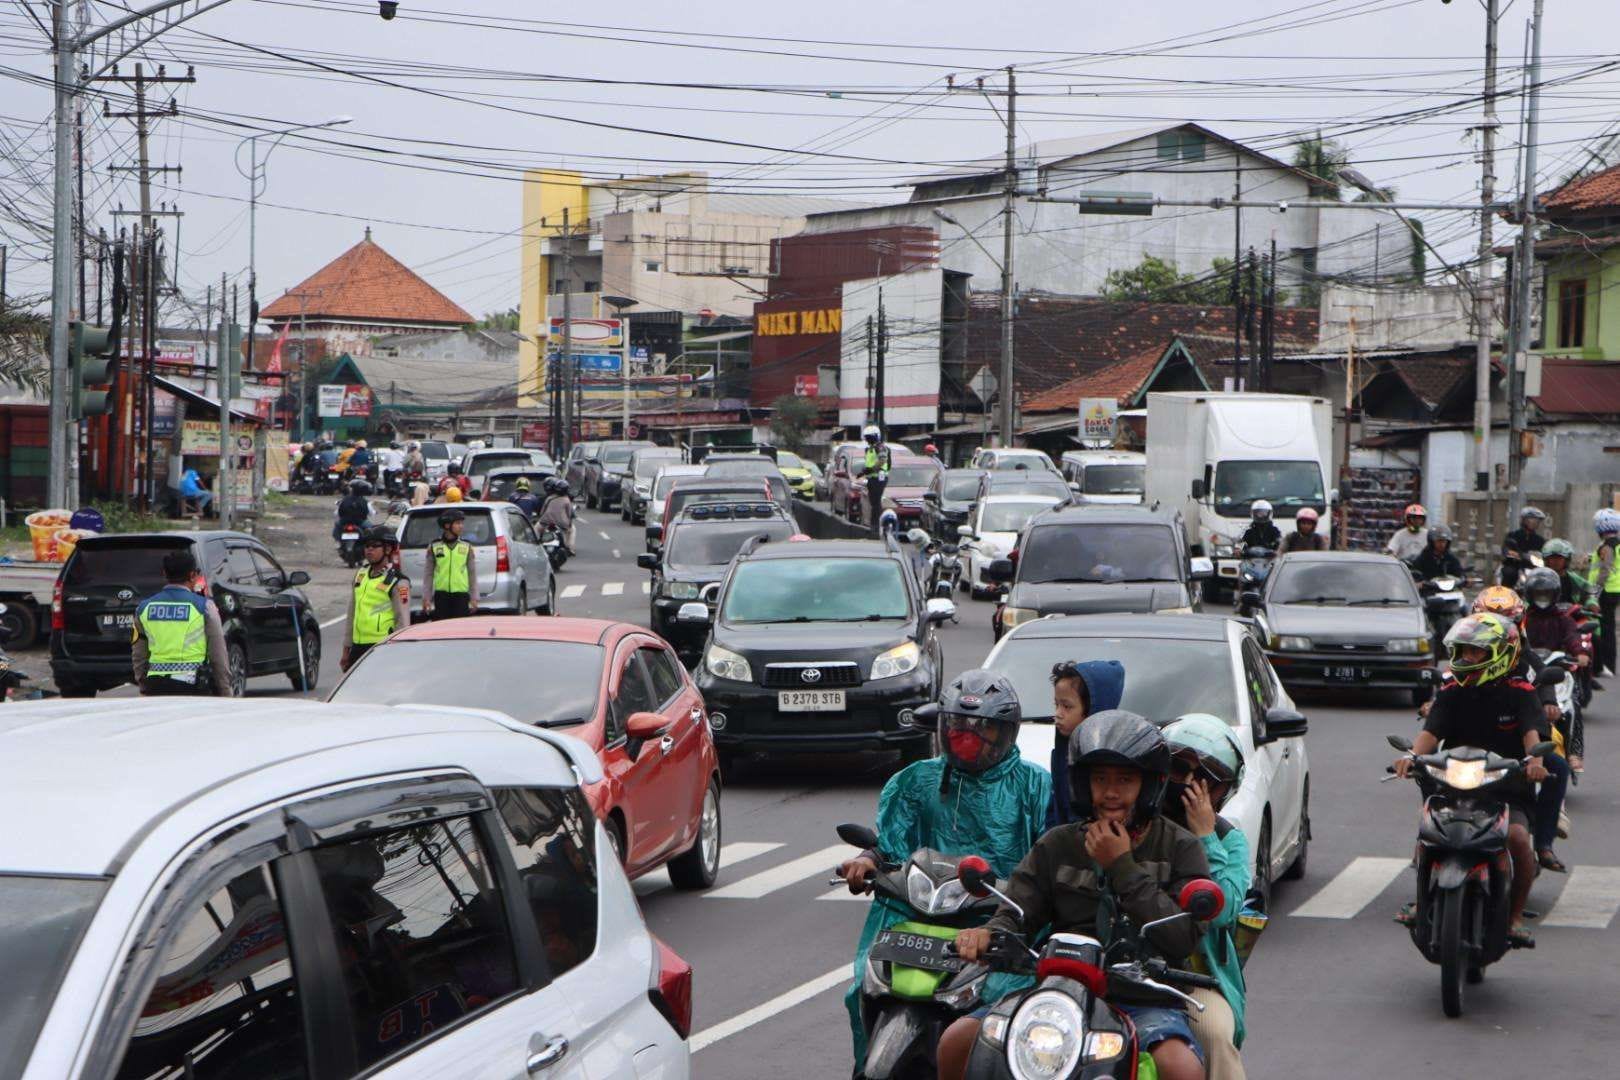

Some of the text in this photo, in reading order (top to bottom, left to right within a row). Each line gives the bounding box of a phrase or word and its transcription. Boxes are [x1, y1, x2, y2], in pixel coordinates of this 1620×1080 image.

[758, 311, 798, 336] NIKI
[149, 605, 189, 620] POLISI
[783, 692, 842, 705] B 2378 STB
[897, 933, 934, 952] 5685
